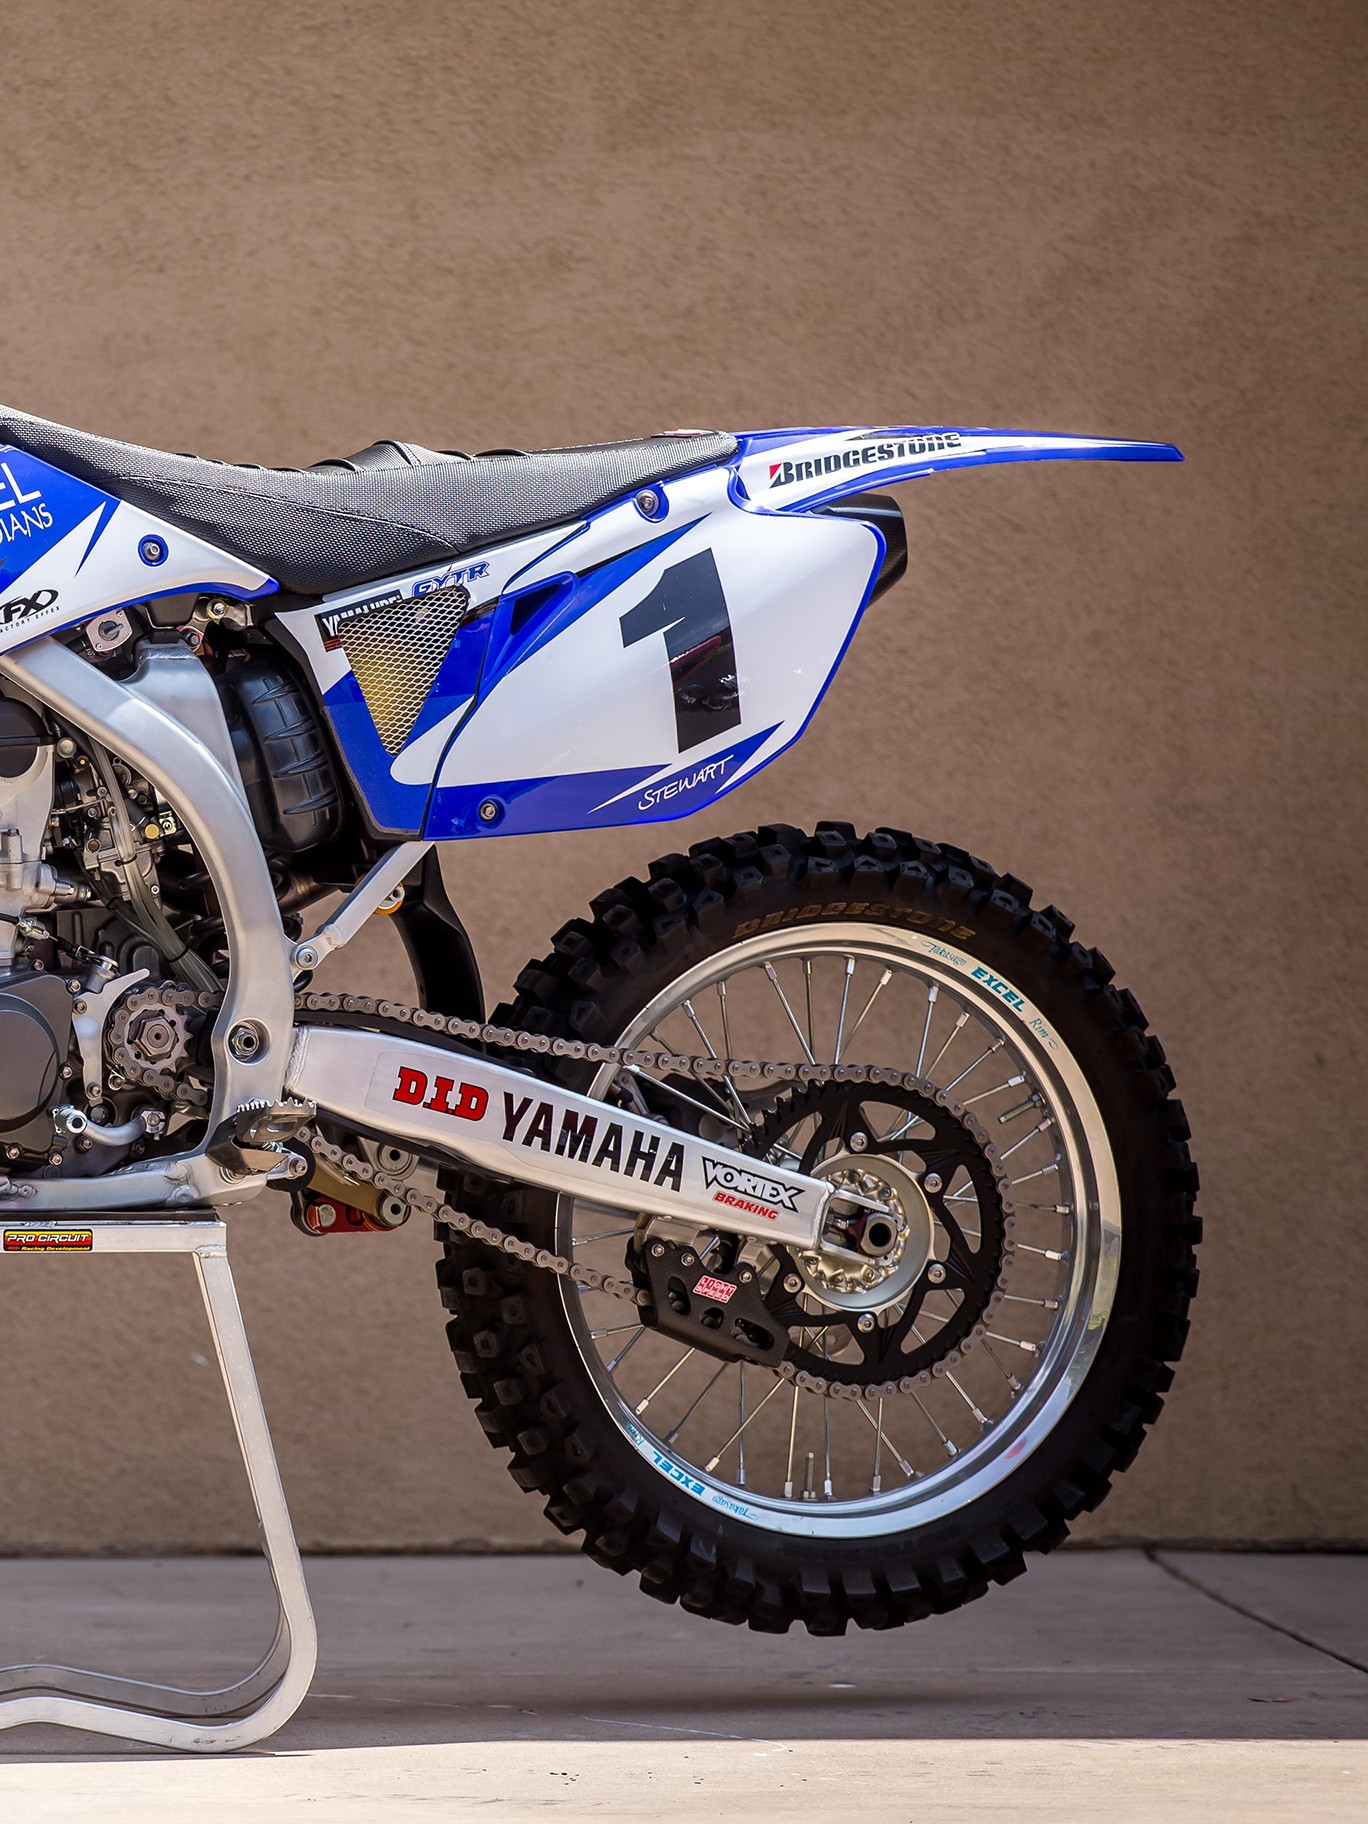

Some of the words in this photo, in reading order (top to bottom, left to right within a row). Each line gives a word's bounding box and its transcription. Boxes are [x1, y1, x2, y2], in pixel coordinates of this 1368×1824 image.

[770, 432, 962, 489] BRIDGESTONE
[35, 605, 61, 620] EFFEX
[618, 547, 742, 754] 1
[638, 754, 734, 811] STEWART
[921, 941, 967, 966] Takasago
[970, 966, 1025, 1012] EXCEL
[1029, 1017, 1059, 1050] Rim
[501, 1091, 686, 1193] YAMAHA
[702, 1156, 806, 1213] VORTEX
[714, 1191, 780, 1221] BRAKING
[7, 1234, 35, 1244] PRO
[38, 1234, 90, 1244] CIRCUIT
[653, 1450, 706, 1497] EXCEL
[712, 1495, 759, 1520] Takasago
